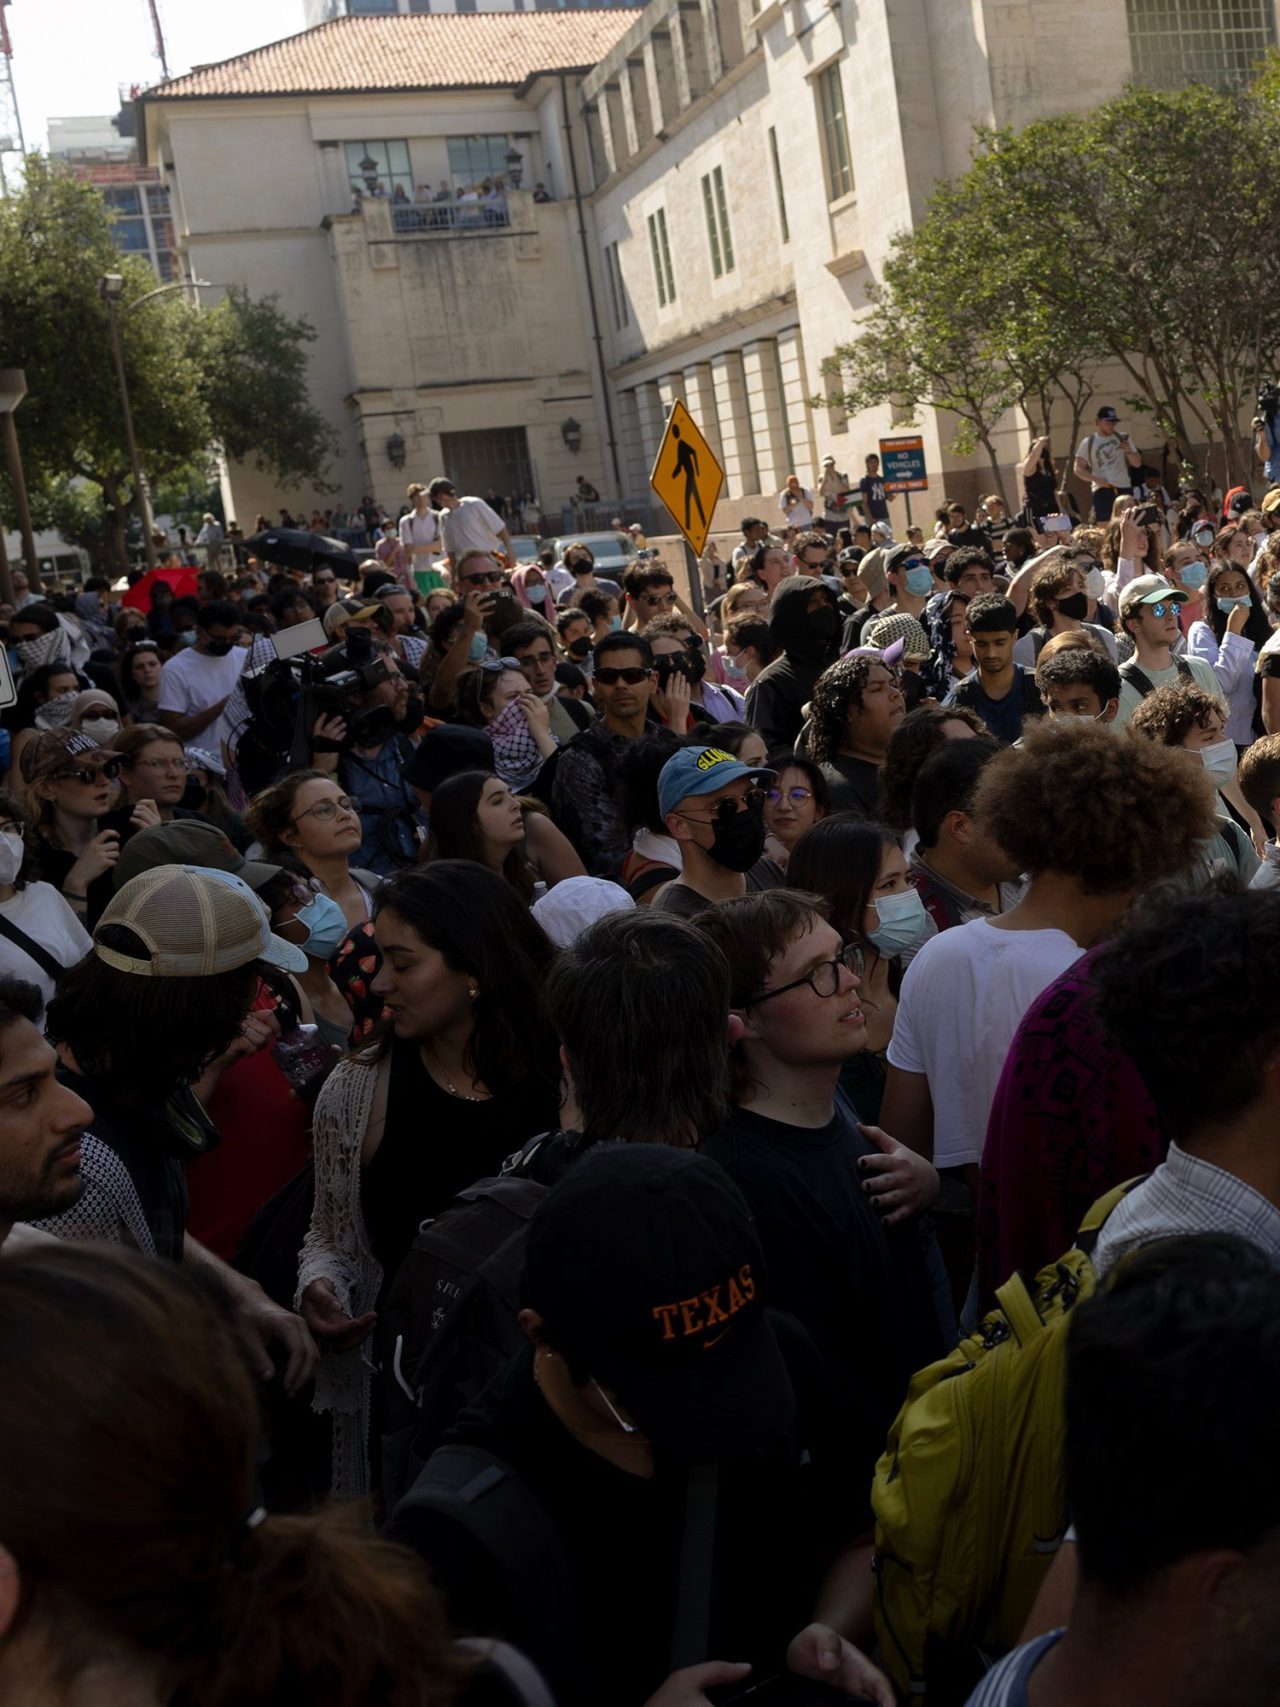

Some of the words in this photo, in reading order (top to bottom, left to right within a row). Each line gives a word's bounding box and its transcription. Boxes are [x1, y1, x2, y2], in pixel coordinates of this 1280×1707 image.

[897, 452, 908, 460] NO
[886, 460, 921, 469] VEHICLES
[651, 1263, 757, 1340] TEXAS
